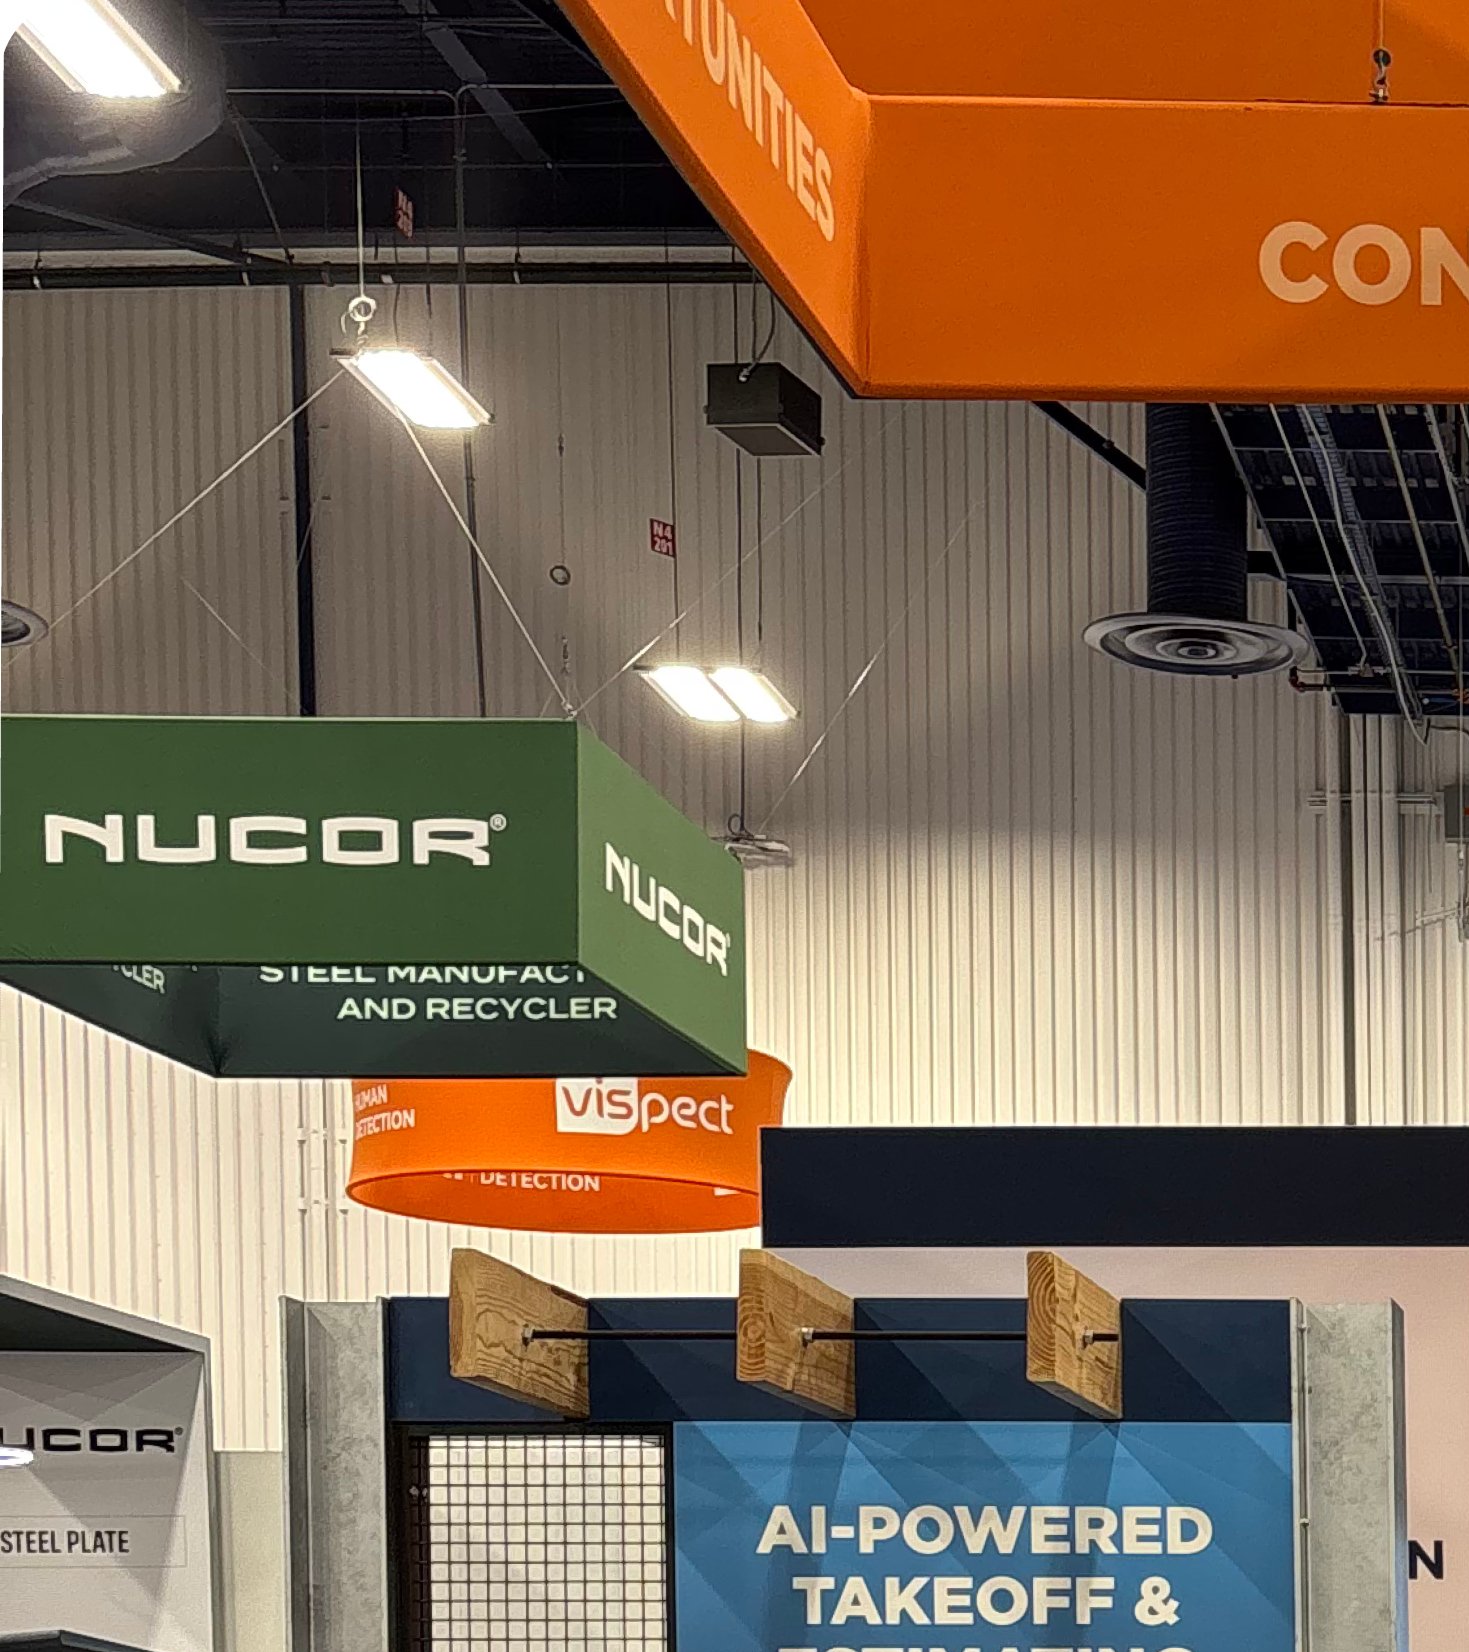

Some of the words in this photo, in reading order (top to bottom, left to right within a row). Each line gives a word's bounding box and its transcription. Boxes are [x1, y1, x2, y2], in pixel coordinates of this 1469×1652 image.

[337, 997, 416, 1020] AND
[426, 996, 617, 1020] RECYCLER
[480, 1171, 600, 1192] DETECTION
[0, 1530, 62, 1554] STEEL
[66, 1530, 130, 1554] PLATE
[756, 1505, 1213, 1555] AI-POWERED
[793, 1575, 1115, 1626] TAKEOFF
[1134, 1576, 1180, 1626] &
